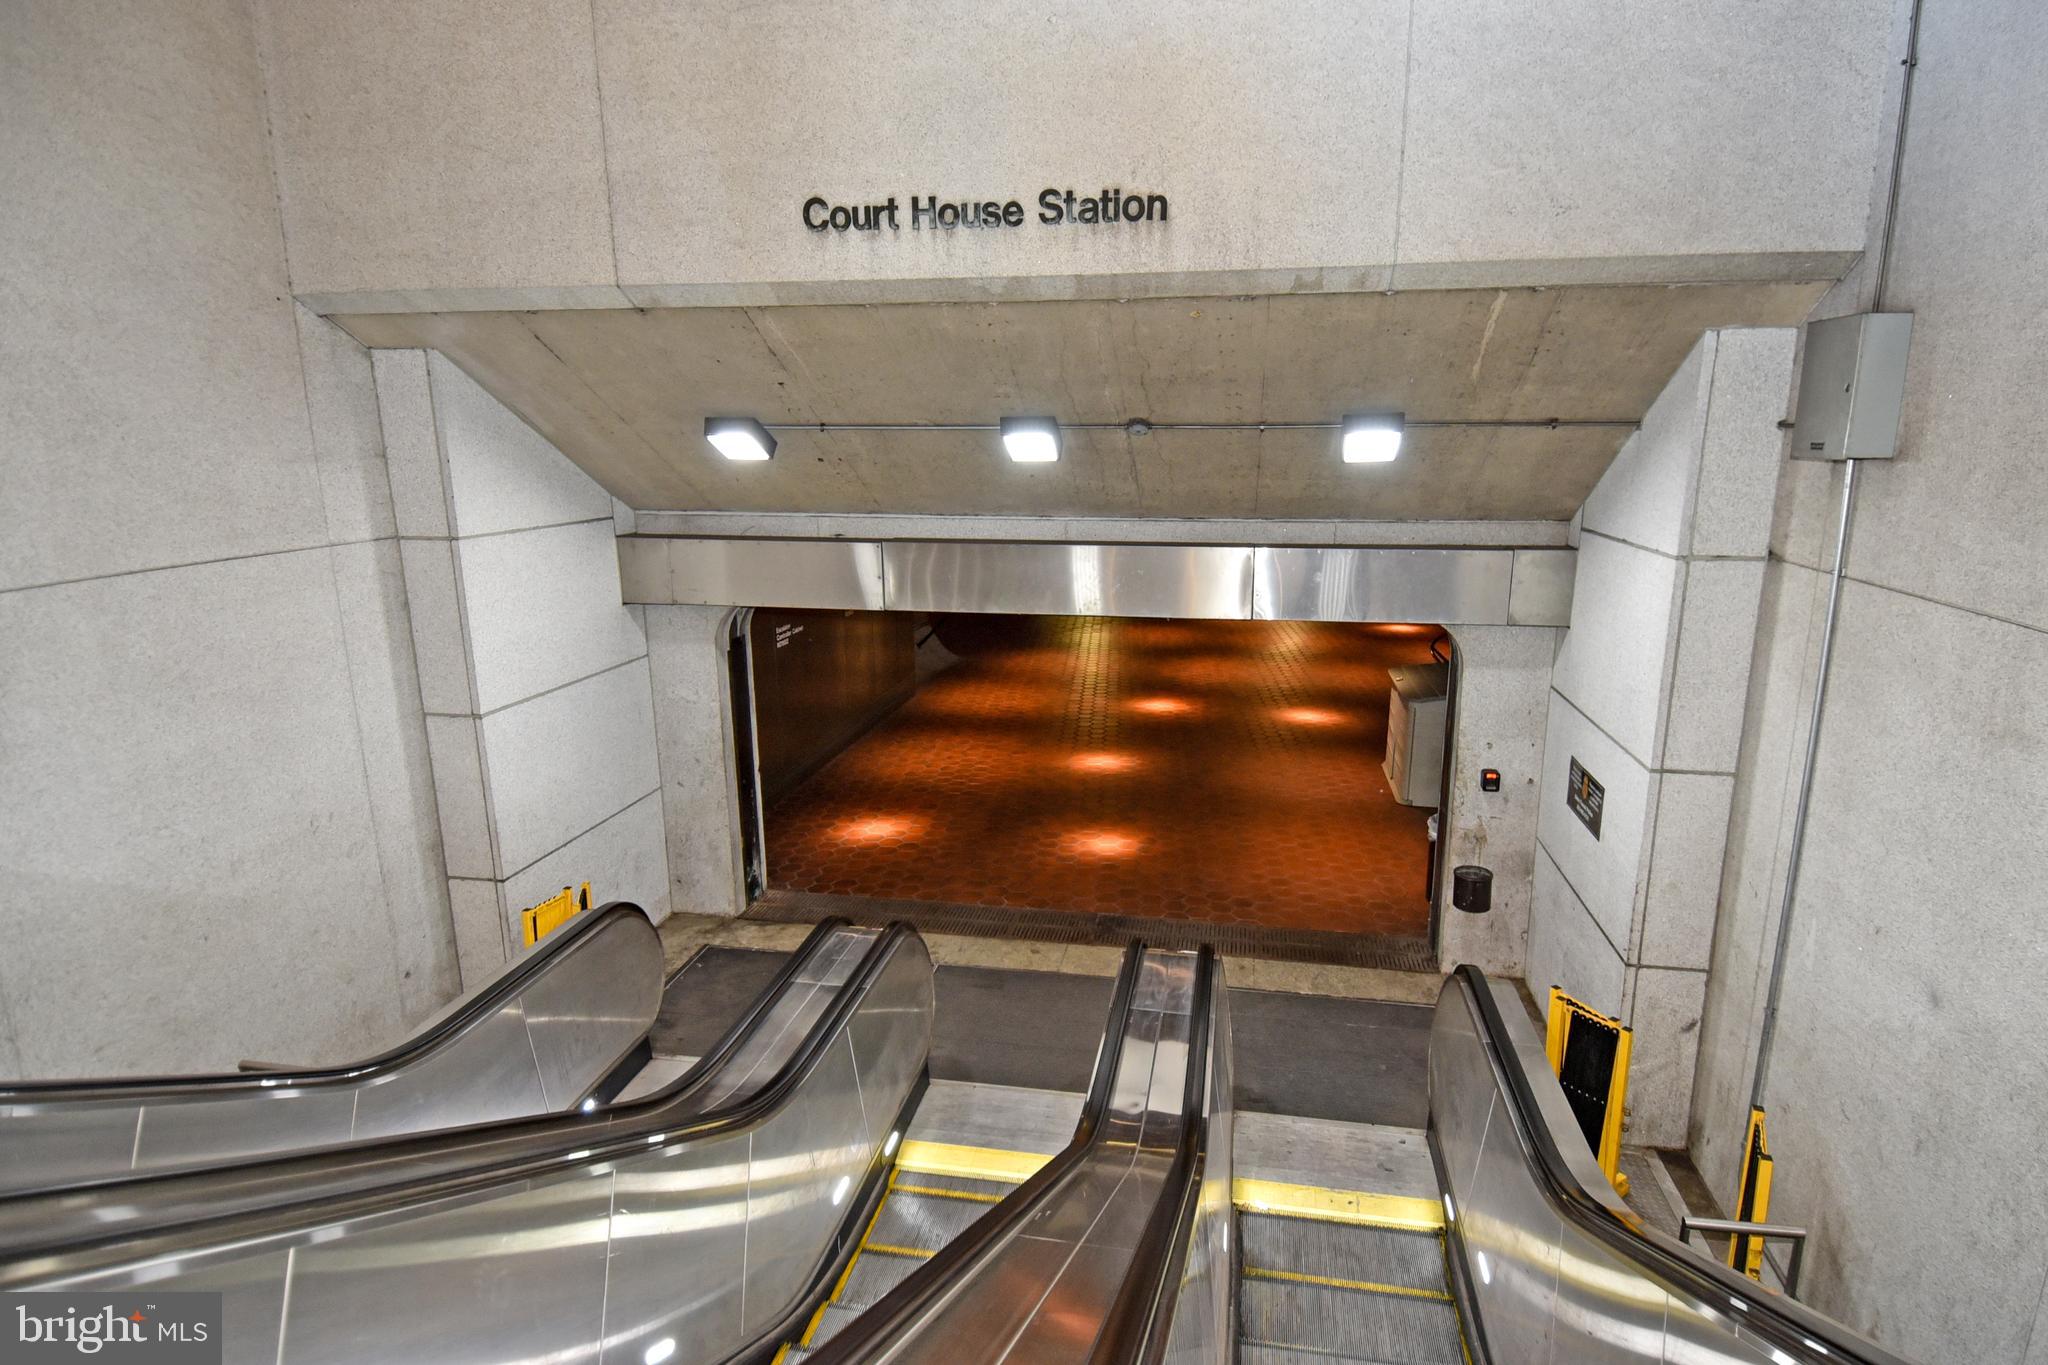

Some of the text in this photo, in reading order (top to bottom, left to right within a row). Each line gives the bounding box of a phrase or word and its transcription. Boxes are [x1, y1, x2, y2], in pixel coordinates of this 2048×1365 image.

[803, 189, 1168, 231] Court House Station
